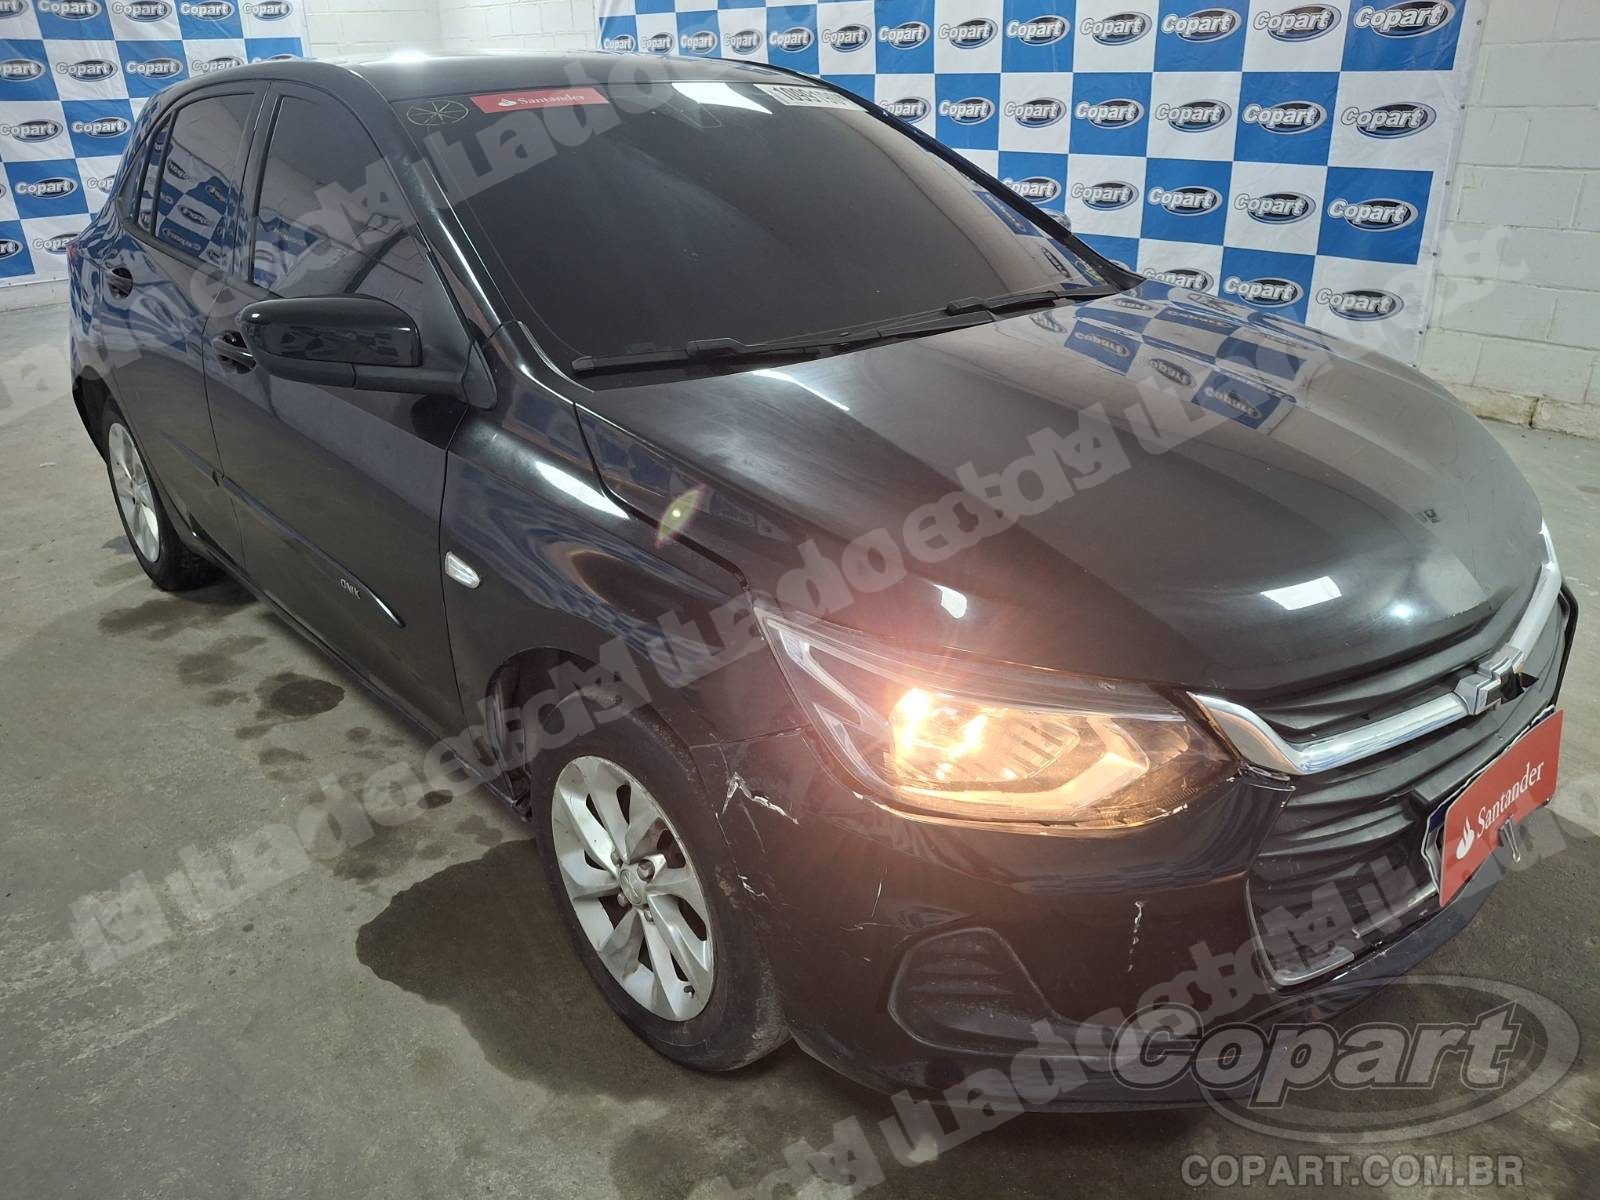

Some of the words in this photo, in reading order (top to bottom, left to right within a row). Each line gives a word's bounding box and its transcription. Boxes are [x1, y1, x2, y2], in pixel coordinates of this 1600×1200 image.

[0, 0, 17, 13] art
[38, 0, 92, 14] Copart
[112, 2, 166, 16] Copart
[180, 3, 230, 16] Copart
[243, 3, 288, 16] Copart
[1354, 1, 1448, 29] Copart
[1007, 18, 1063, 41] Copart
[1080, 16, 1142, 41] Copart
[1161, 12, 1235, 37] Copart
[1253, 8, 1331, 34] Copart
[769, 31, 808, 48] Copart
[822, 28, 865, 45] Copart
[879, 25, 923, 43] Copart
[939, 22, 990, 42] Copart
[604, 38, 632, 50] Copart
[641, 36, 670, 50] Copart
[680, 35, 713, 50] Copart
[724, 33, 758, 49] Copart
[0, 62, 37, 77] part
[56, 62, 108, 77] Copart
[126, 60, 177, 75] Copart
[192, 58, 238, 73] Copart
[518, 93, 584, 105] Santander
[939, 101, 988, 120] Copart
[1004, 101, 1058, 120] Copart
[1075, 101, 1136, 123] Copart
[1155, 103, 1221, 126] Copart
[1243, 105, 1316, 128] Copart
[1341, 106, 1424, 131] Copart
[0, 122, 55, 138] Copart
[72, 120, 124, 135] Copart
[15, 180, 70, 195] Copart
[87, 177, 114, 192] Cop
[1070, 183, 1132, 204] Copart
[1148, 186, 1215, 209] Copart
[1234, 193, 1305, 217] Copart
[1327, 198, 1407, 224] Copart
[33, 237, 67, 251] Copa
[1224, 276, 1296, 301] Copart
[1316, 288, 1392, 313] Copart
[1477, 761, 1545, 838] Santander
